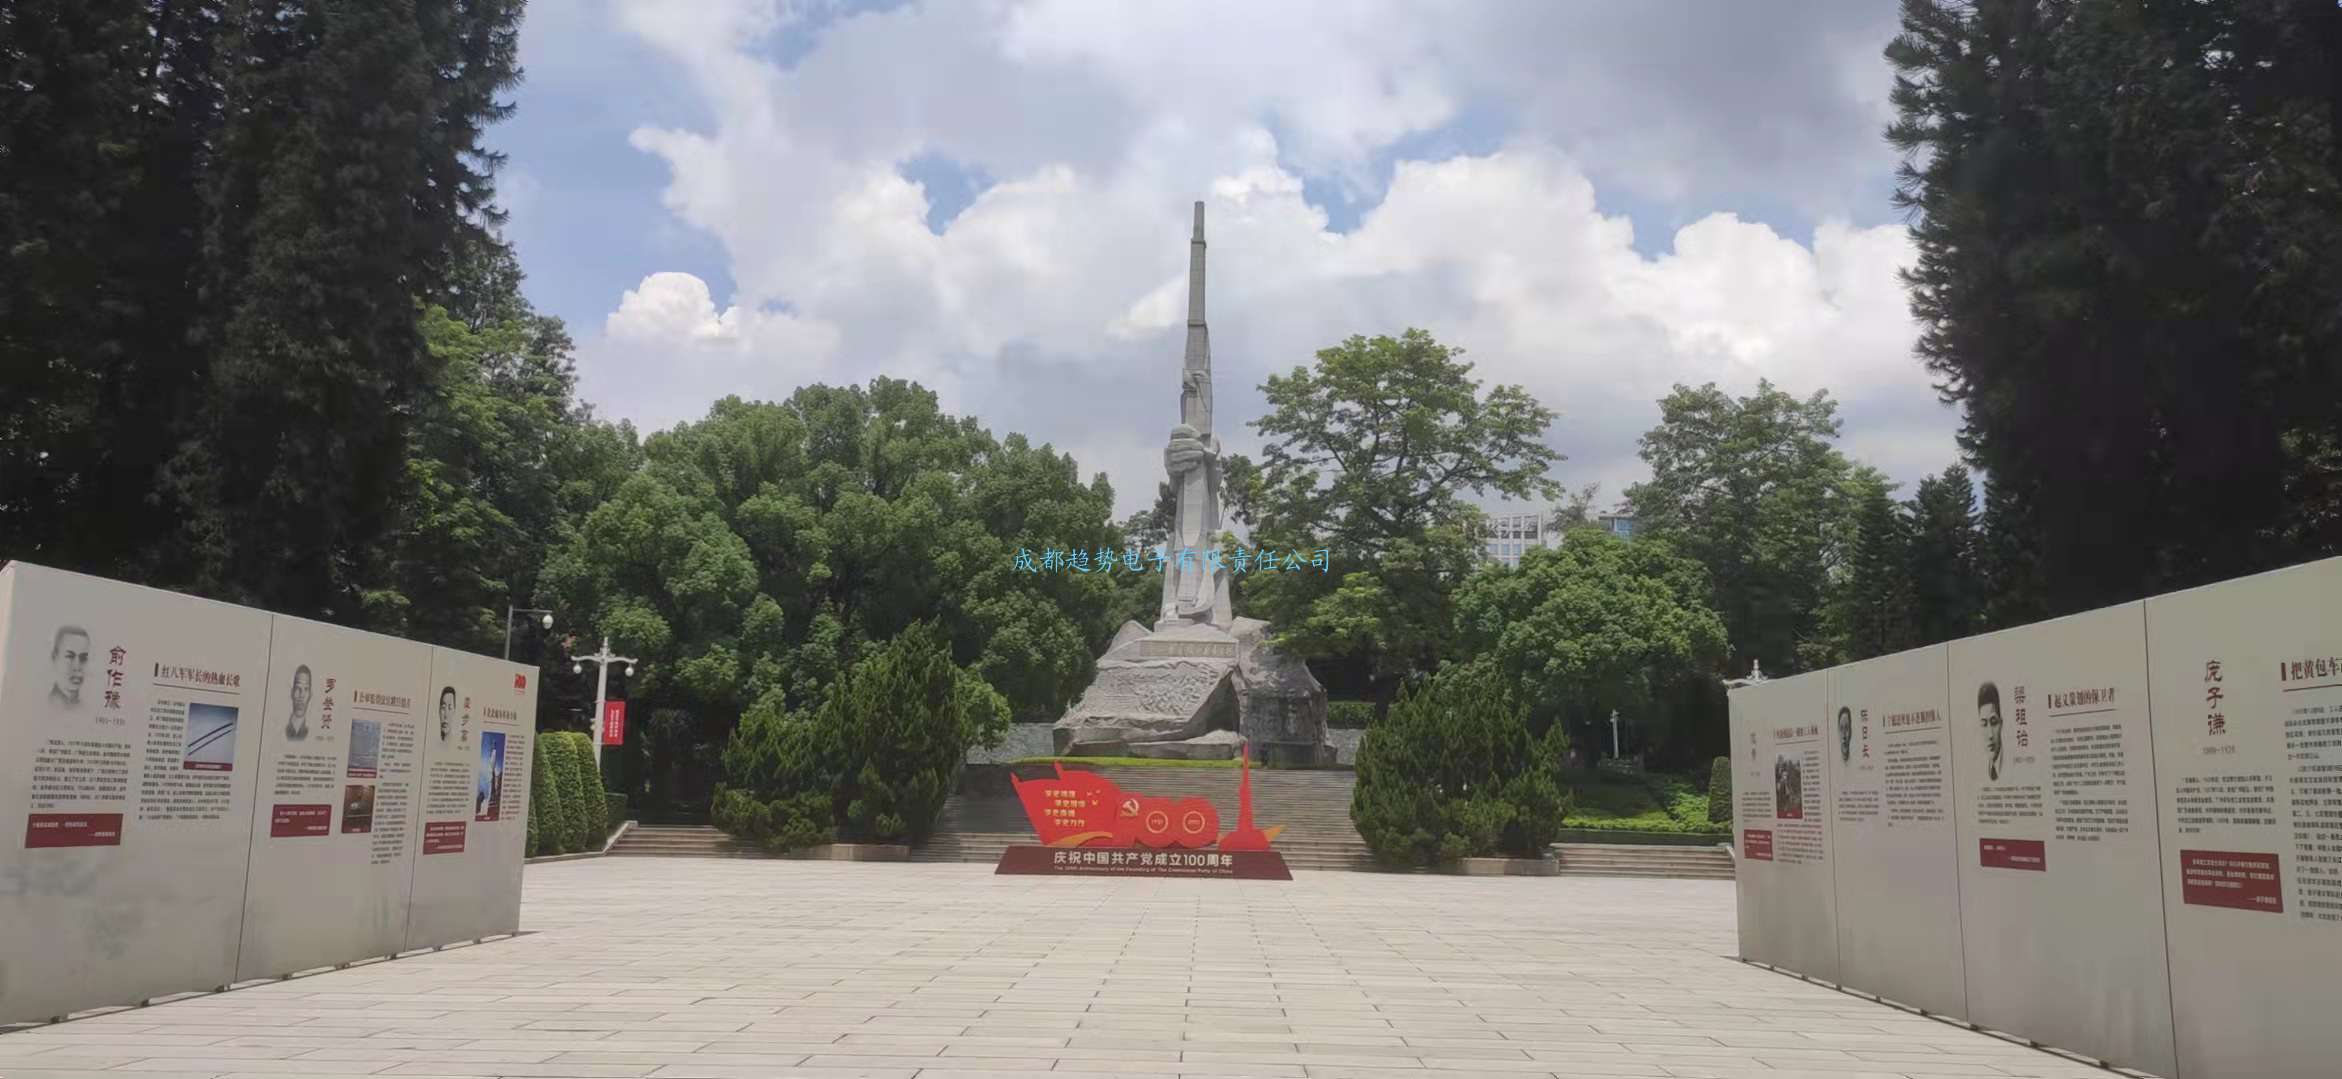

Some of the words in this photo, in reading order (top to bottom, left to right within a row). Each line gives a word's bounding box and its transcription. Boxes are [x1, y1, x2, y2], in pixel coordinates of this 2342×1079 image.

[2291, 657, 2342, 680] 把黄包车
[1054, 851, 1233, 867] 庆祝中国共产党成立100周年
